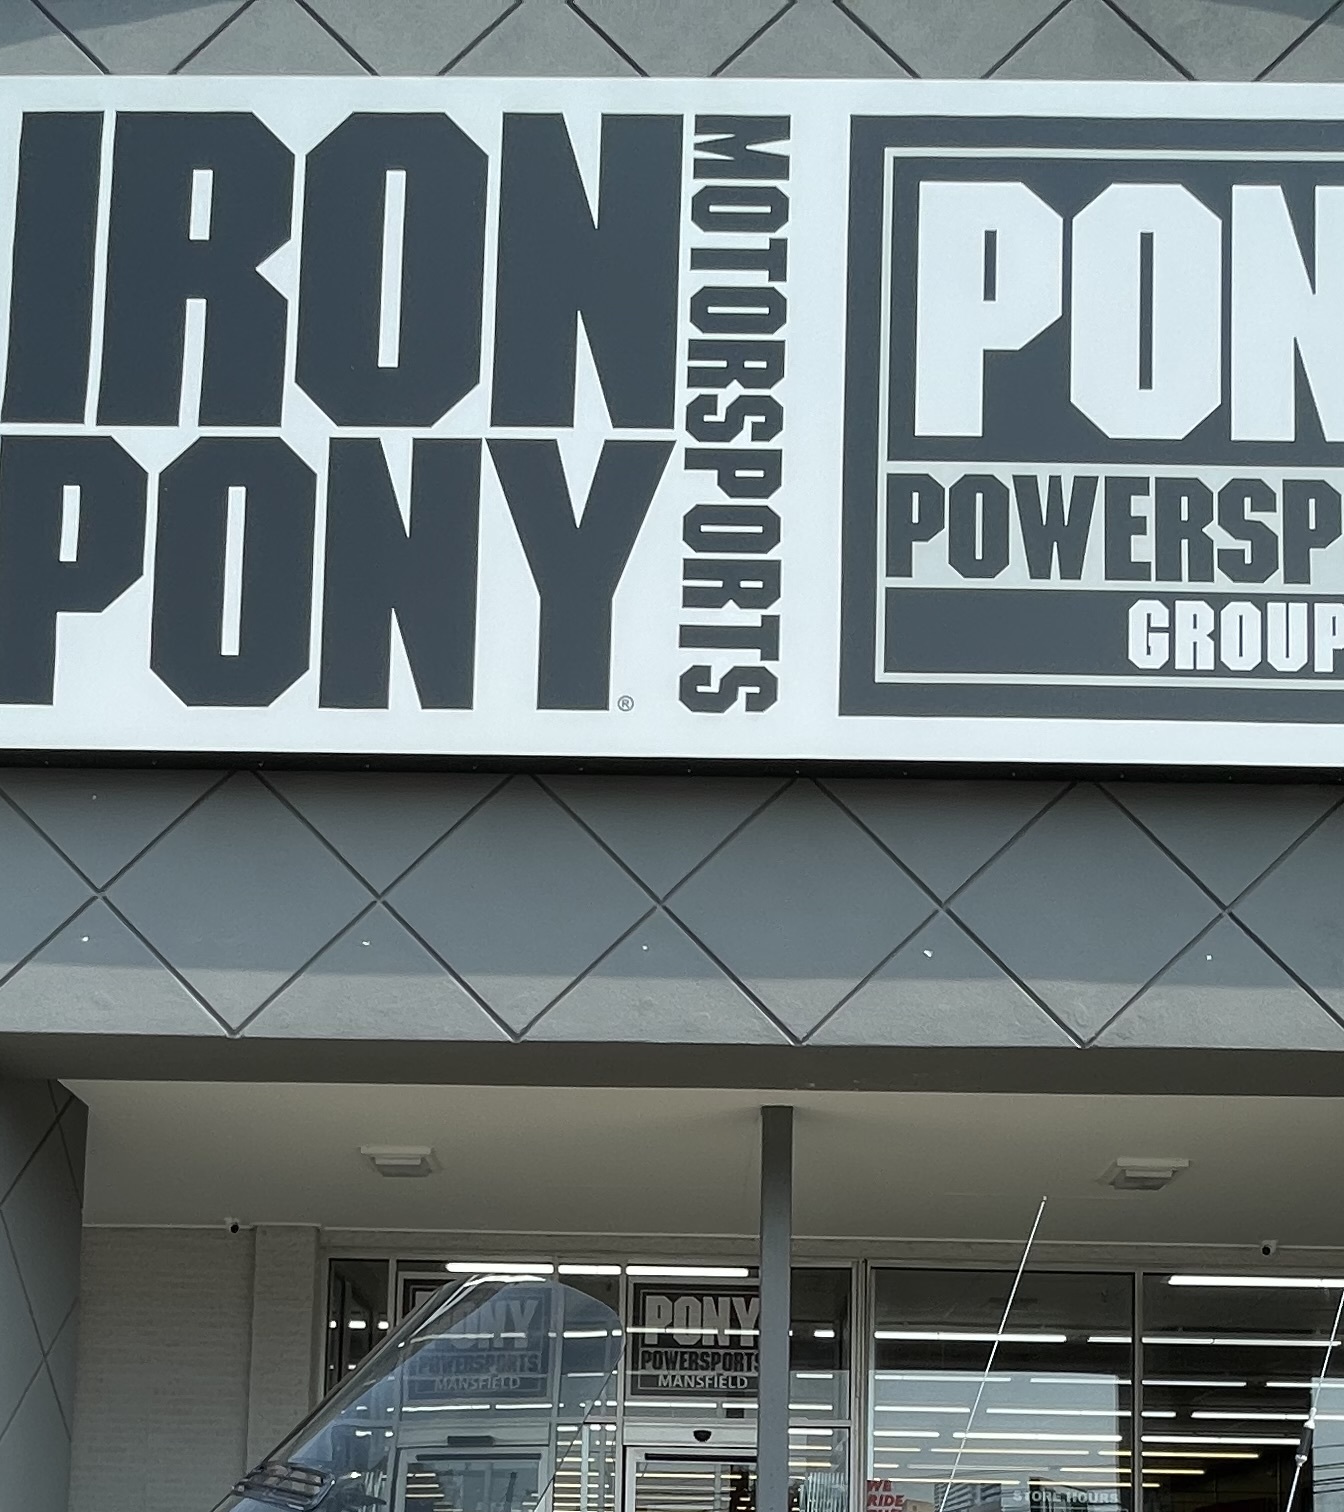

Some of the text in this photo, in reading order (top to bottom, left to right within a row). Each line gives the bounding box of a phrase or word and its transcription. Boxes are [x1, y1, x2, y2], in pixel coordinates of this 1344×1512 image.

[0, 110, 684, 429] IRON
[678, 113, 792, 714] MOTORSPORTS
[644, 1295, 760, 1347] PONY
[434, 1375, 522, 1391] MANSFIELD
[658, 1374, 749, 1389] MANSFIELD
[867, 1494, 905, 1507] RIDE
[1066, 1490, 1119, 1505] HOURS
